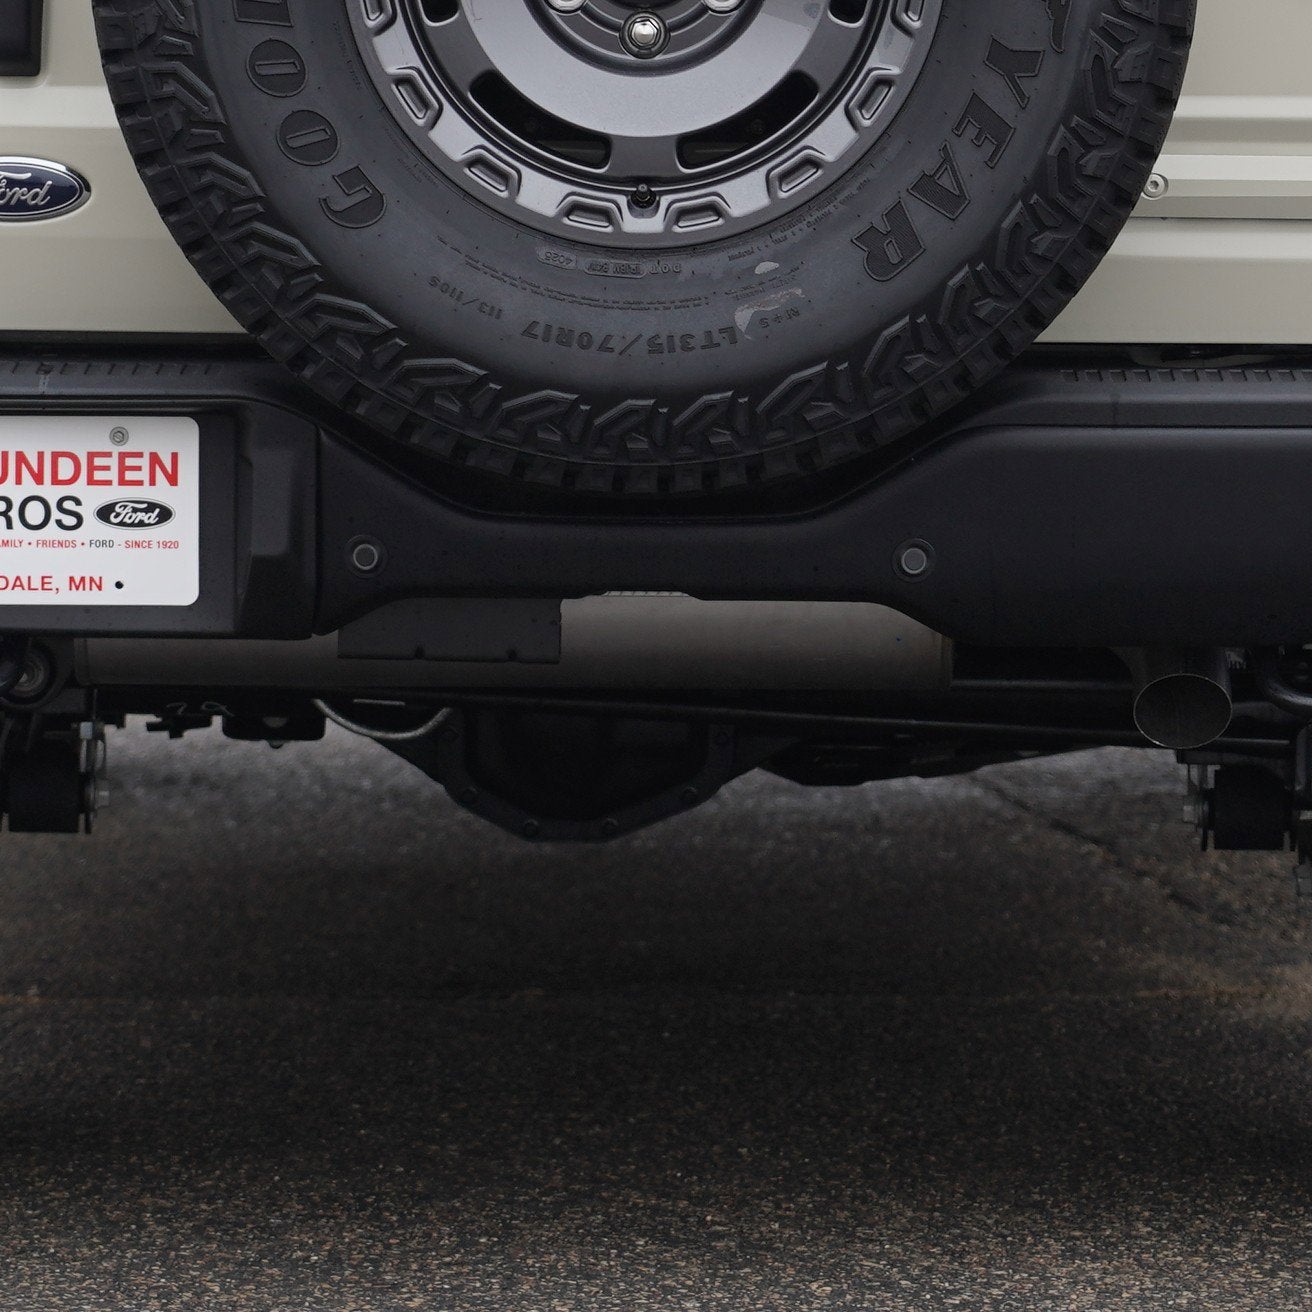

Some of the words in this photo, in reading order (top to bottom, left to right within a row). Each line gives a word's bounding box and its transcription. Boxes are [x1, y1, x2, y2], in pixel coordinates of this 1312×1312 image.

[522, 318, 738, 355] LT315/70R17
[109, 501, 160, 525] Ford
[36, 539, 77, 548] FRIENDS
[89, 539, 115, 548] FORD
[124, 540, 153, 549] SINCE
[156, 540, 179, 549] 1920
[68, 575, 104, 591] MN
